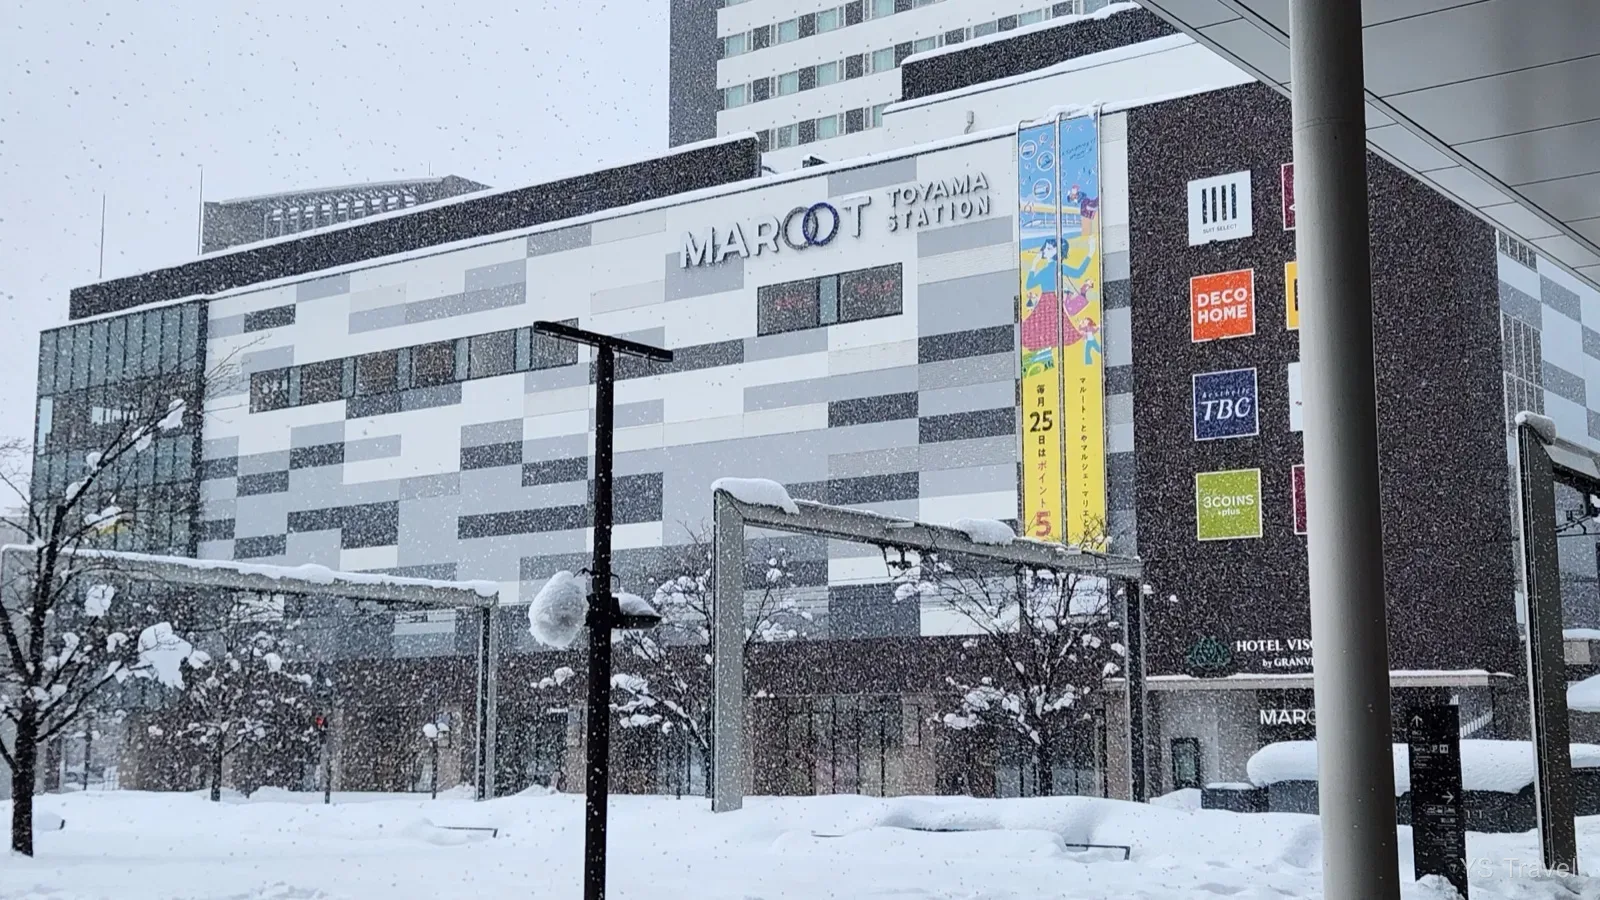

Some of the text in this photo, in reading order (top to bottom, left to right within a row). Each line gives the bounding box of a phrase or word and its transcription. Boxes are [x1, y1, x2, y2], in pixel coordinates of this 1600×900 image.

[886, 171, 989, 205] TOYAMA
[887, 196, 991, 232] STATION
[680, 195, 872, 269] MAROOT
[1216, 223, 1237, 231] SELECT
[1197, 287, 1248, 307] DECO
[1197, 304, 1248, 324] HOME
[1200, 397, 1251, 420] TBC
[1203, 494, 1254, 509] 3COINS
[1236, 639, 1284, 652] HOTEL
[1262, 657, 1314, 668] by GRANVI
